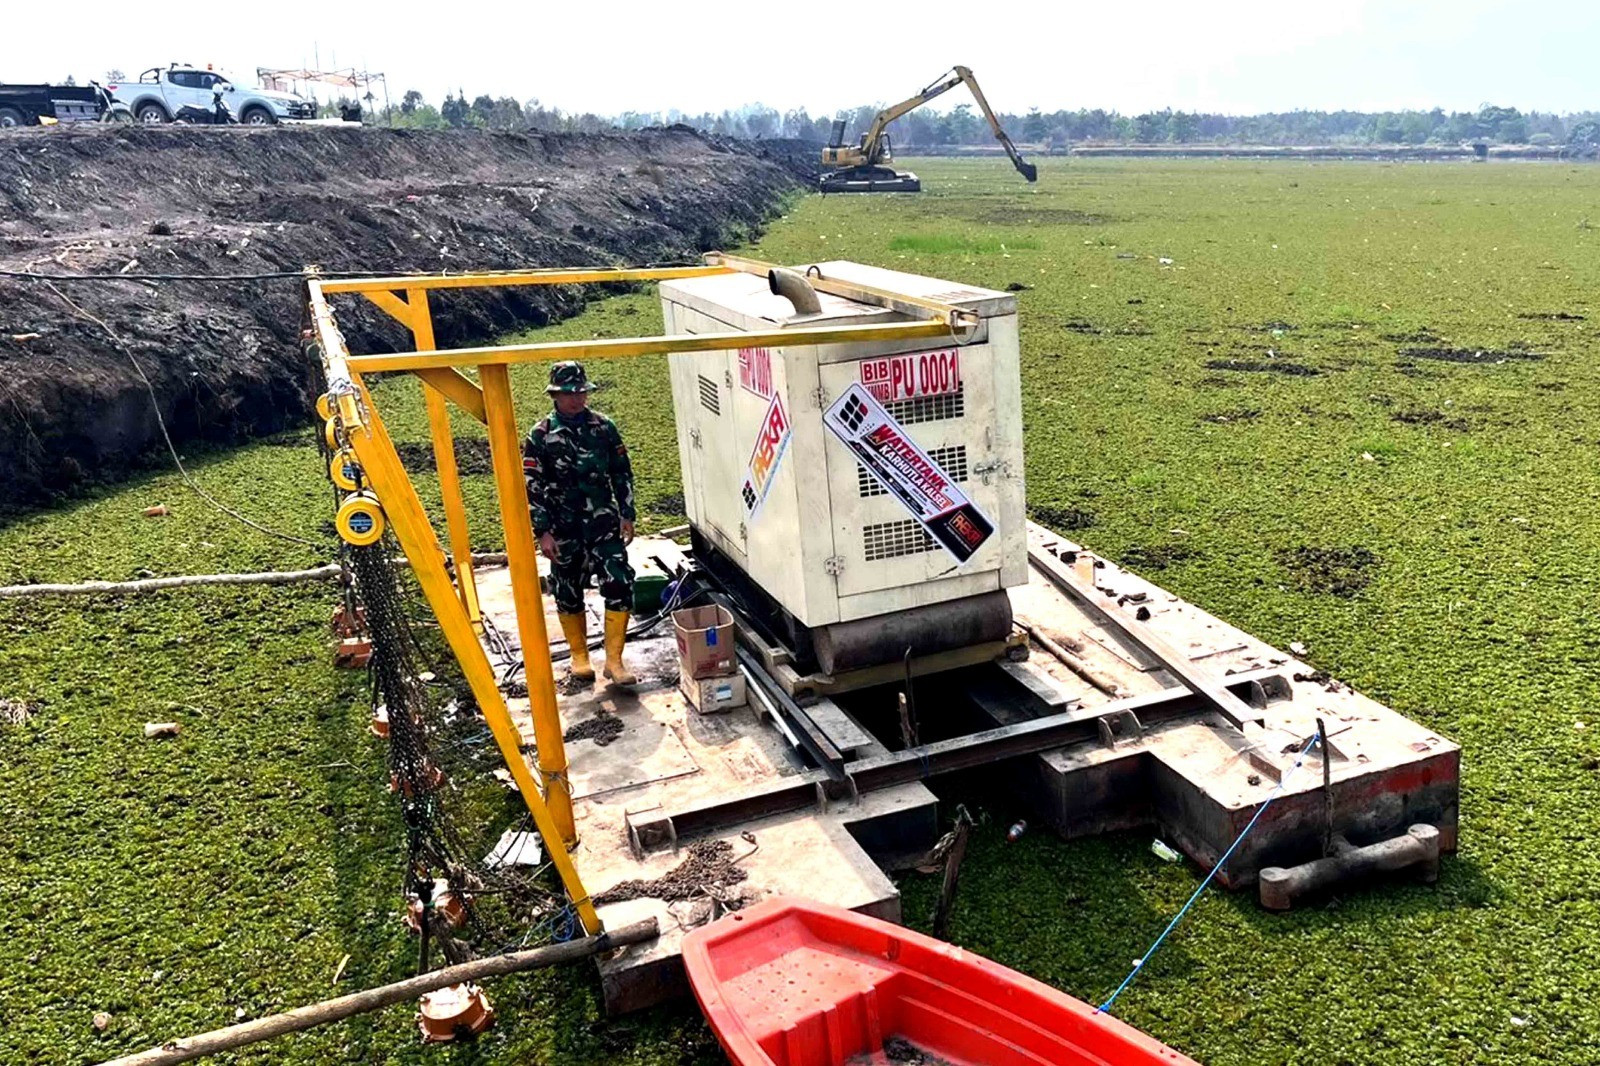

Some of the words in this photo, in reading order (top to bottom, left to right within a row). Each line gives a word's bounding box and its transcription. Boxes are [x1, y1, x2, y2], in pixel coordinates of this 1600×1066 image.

[863, 361, 888, 381] BIB
[892, 358, 915, 398] PU
[920, 352, 957, 394] 0001
[866, 423, 949, 492] WATERTANK
[879, 444, 924, 488] KARHUTLA
[920, 477, 947, 509] KALSEL
